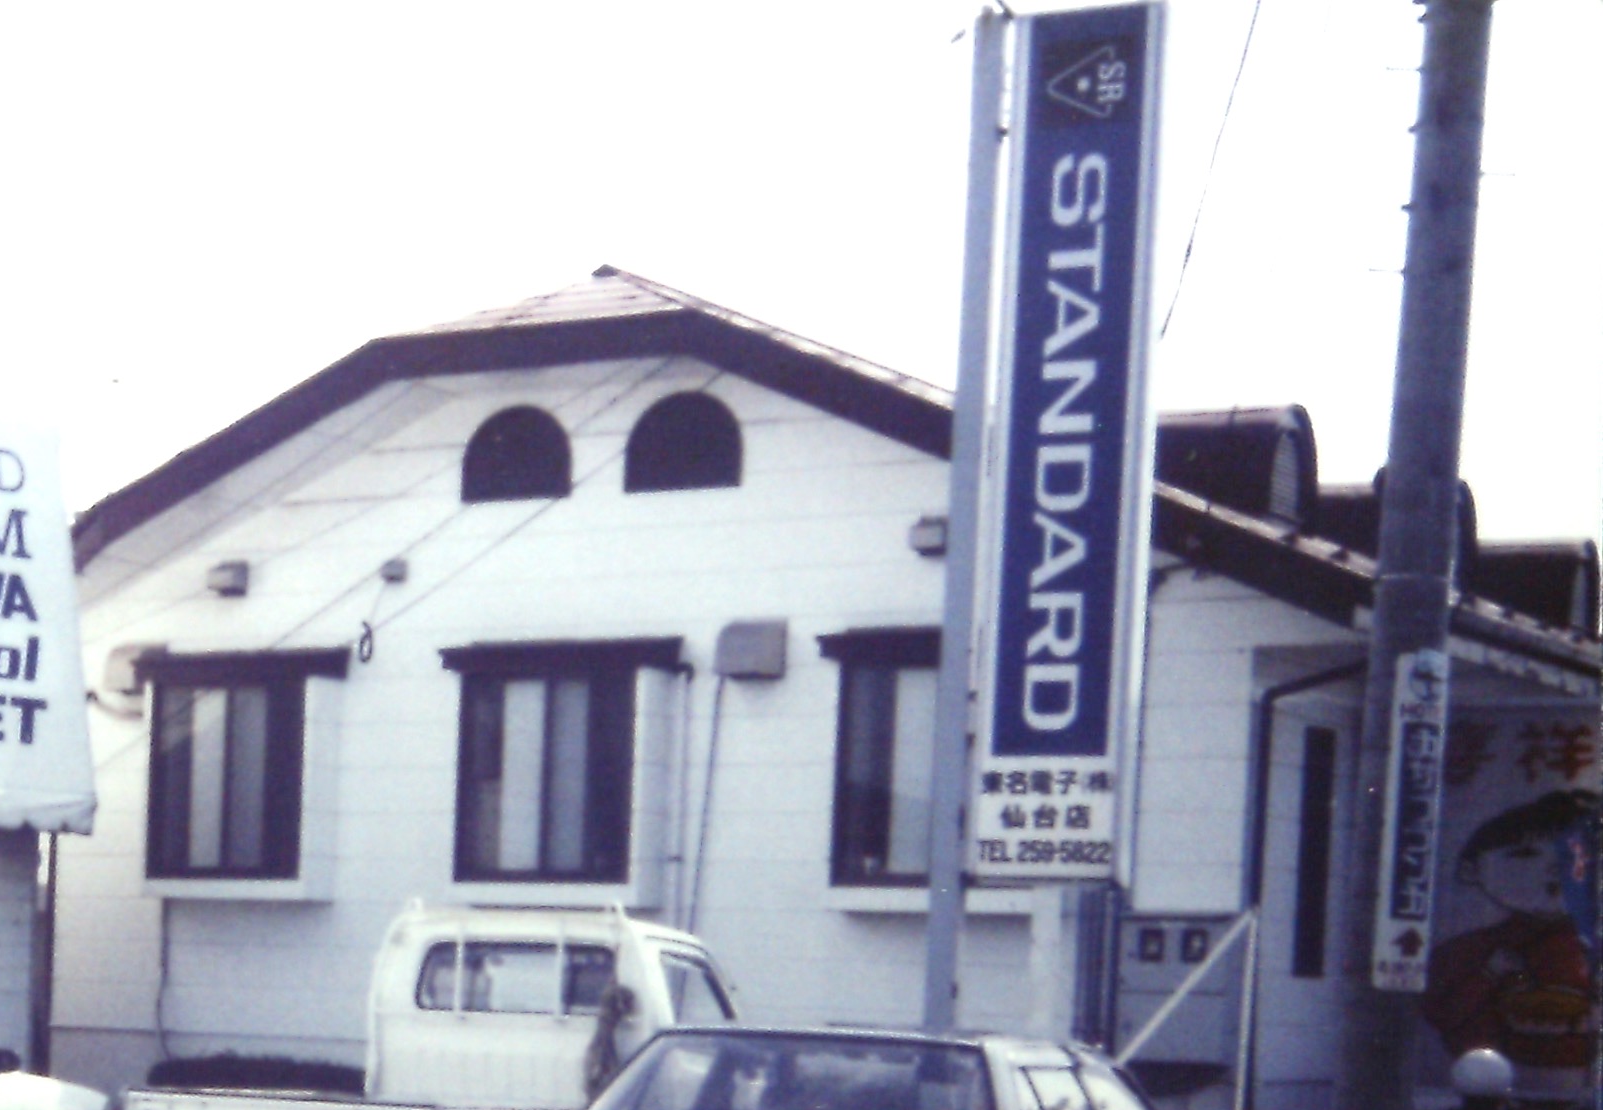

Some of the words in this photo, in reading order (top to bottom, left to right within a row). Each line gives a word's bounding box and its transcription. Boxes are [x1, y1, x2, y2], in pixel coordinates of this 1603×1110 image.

[1021, 153, 1108, 732] STANDARD
[1000, 803, 1091, 830] 仙台店
[977, 838, 1012, 863] TEL
